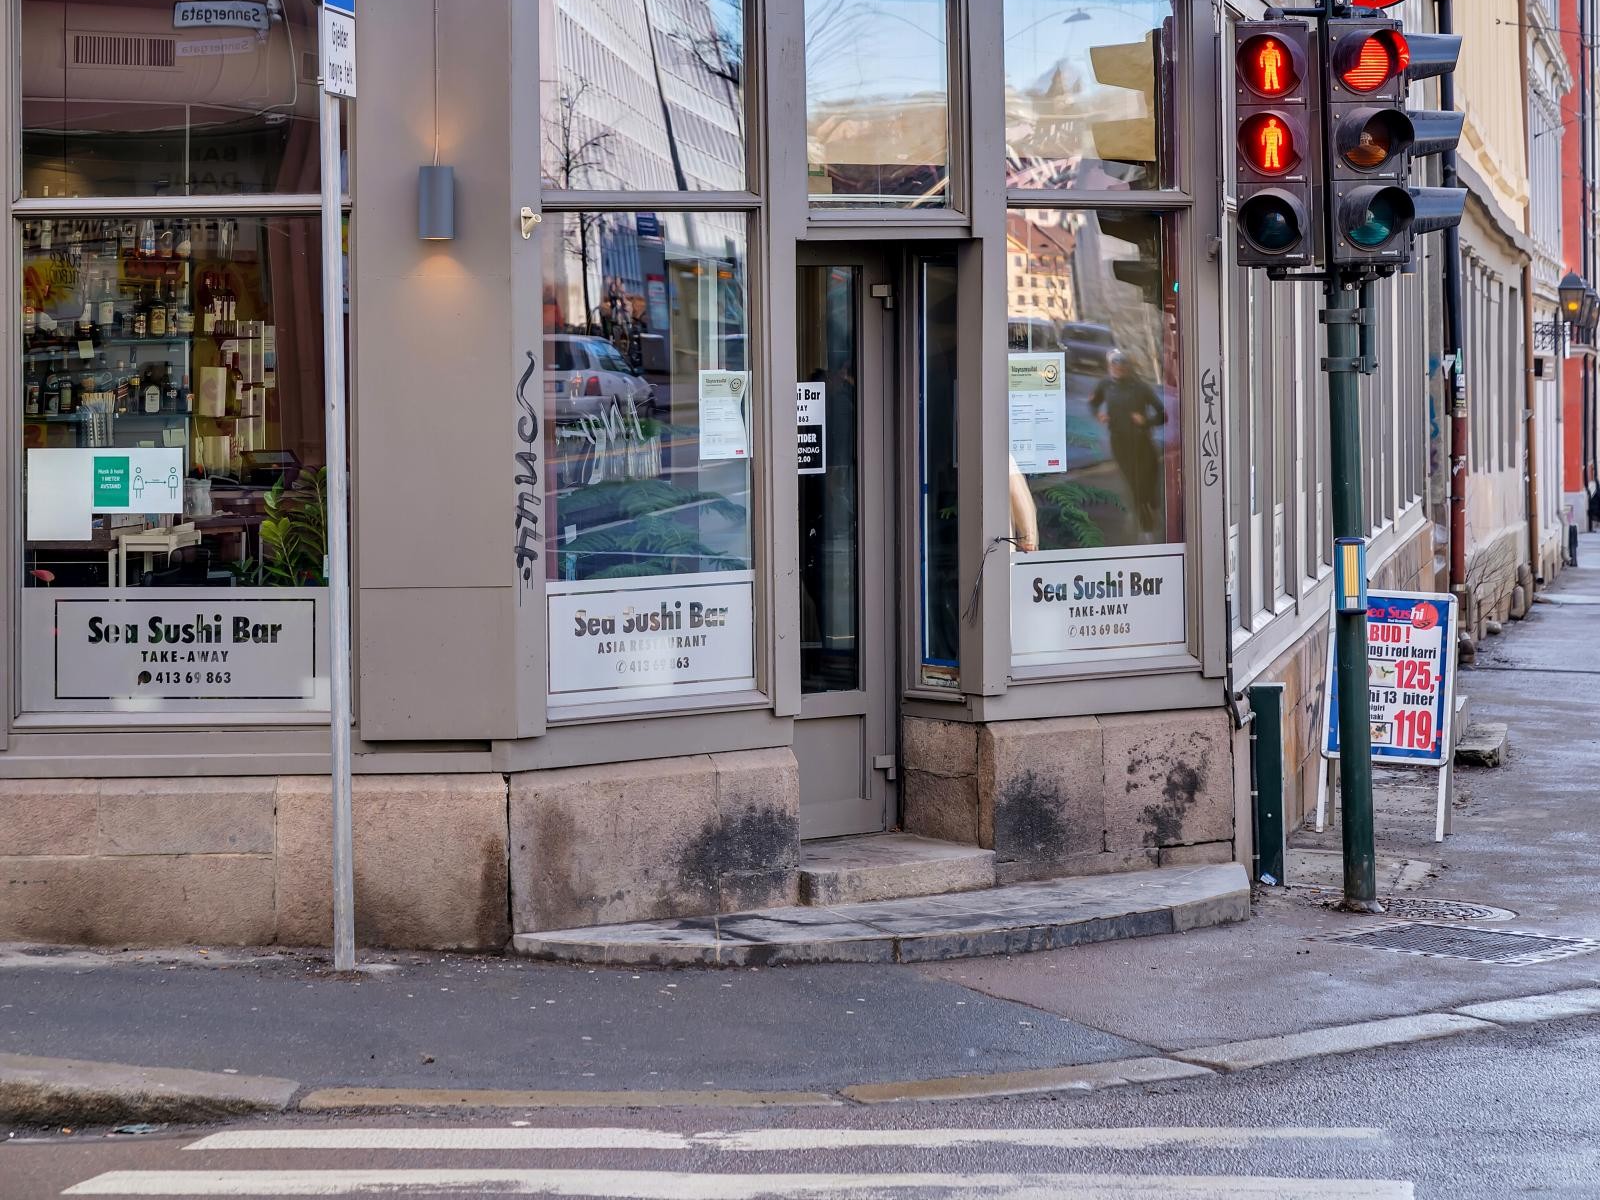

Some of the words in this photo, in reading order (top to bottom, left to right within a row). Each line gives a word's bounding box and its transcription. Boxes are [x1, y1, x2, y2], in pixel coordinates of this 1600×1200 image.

[331, 21, 349, 53] Gjelder
[328, 55, 343, 87] høyre
[344, 59, 353, 85] felt
[804, 388, 821, 401] Bar
[798, 415, 809, 423] 863
[1032, 577, 1068, 603] Sea
[1073, 570, 1124, 600] Sushi
[1130, 571, 1163, 596] Bar
[1069, 603, 1129, 618] TAKE-AWAY
[1387, 604, 1425, 620] Sushi
[574, 609, 616, 637] Sea
[623, 600, 682, 633] Sushi
[689, 601, 729, 629] Bar
[88, 616, 139, 645] Sea
[148, 613, 222, 644] Sushi
[232, 616, 283, 644] Bar
[1079, 624, 1097, 637] 413
[1099, 623, 1111, 636] 69
[1113, 622, 1131, 634] 863
[597, 641, 626, 654] ASIA
[1385, 644, 1389, 657] i
[1391, 645, 1409, 658] rød
[1411, 645, 1437, 659] karri
[141, 650, 229, 663] TAKE-AWAY
[155, 671, 181, 684] 413
[185, 671, 202, 684] 69
[206, 671, 232, 684] 863
[1382, 690, 1397, 704] 13
[1402, 692, 1435, 706] biter
